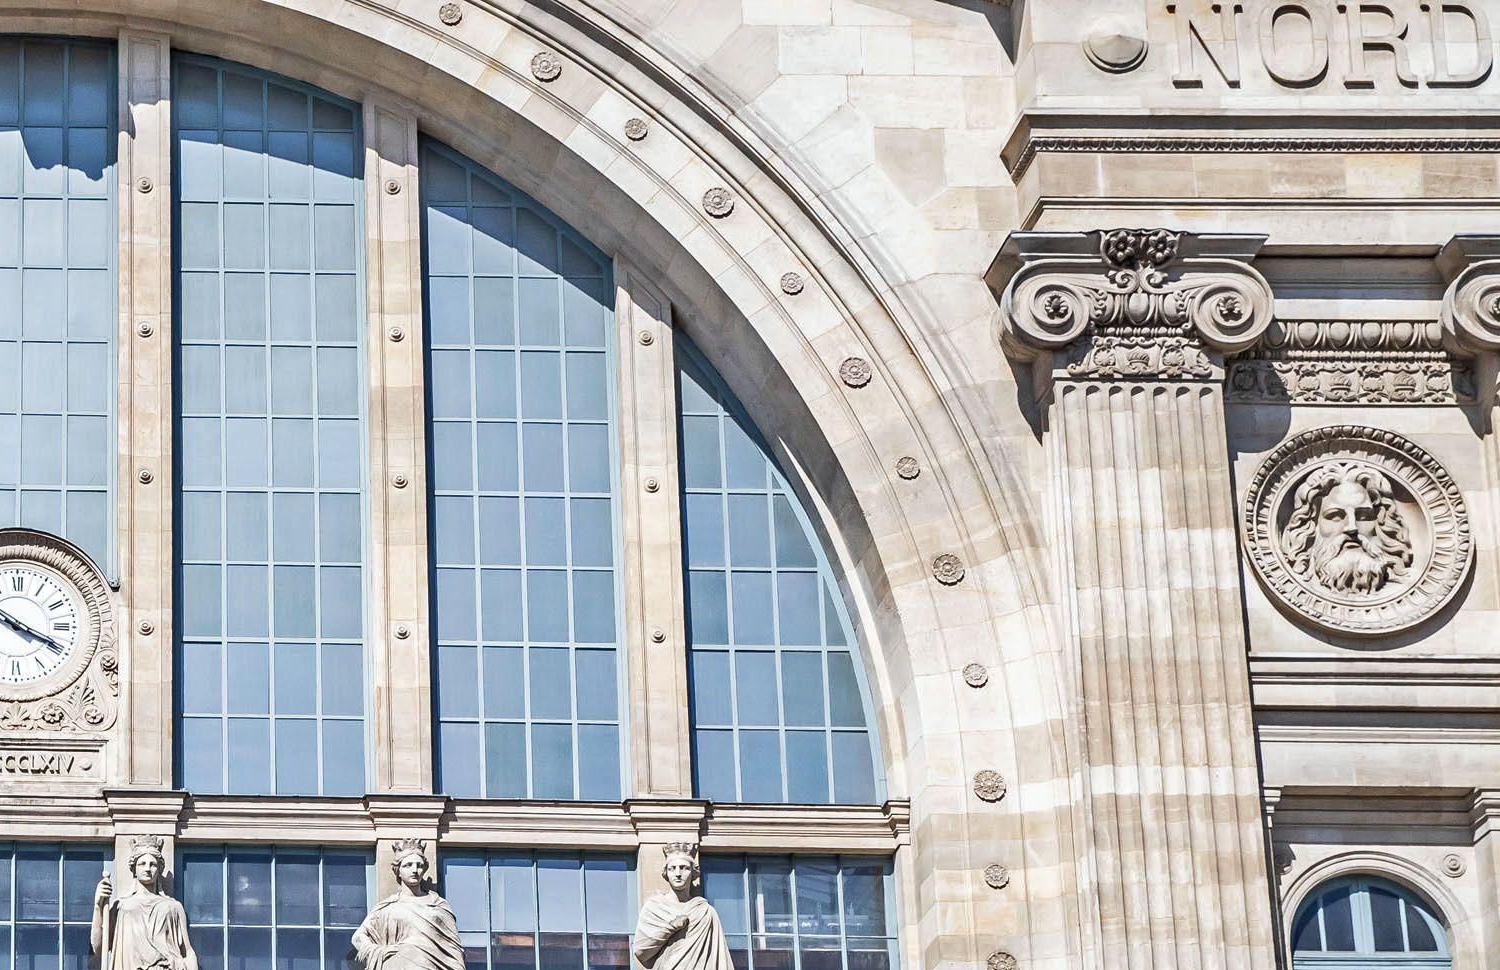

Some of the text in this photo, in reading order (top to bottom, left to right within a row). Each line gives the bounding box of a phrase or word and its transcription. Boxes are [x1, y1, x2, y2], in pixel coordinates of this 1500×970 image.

[1166, 4, 1493, 89] NORD
[48, 599, 64, 611] II
[52, 622, 70, 632] III
